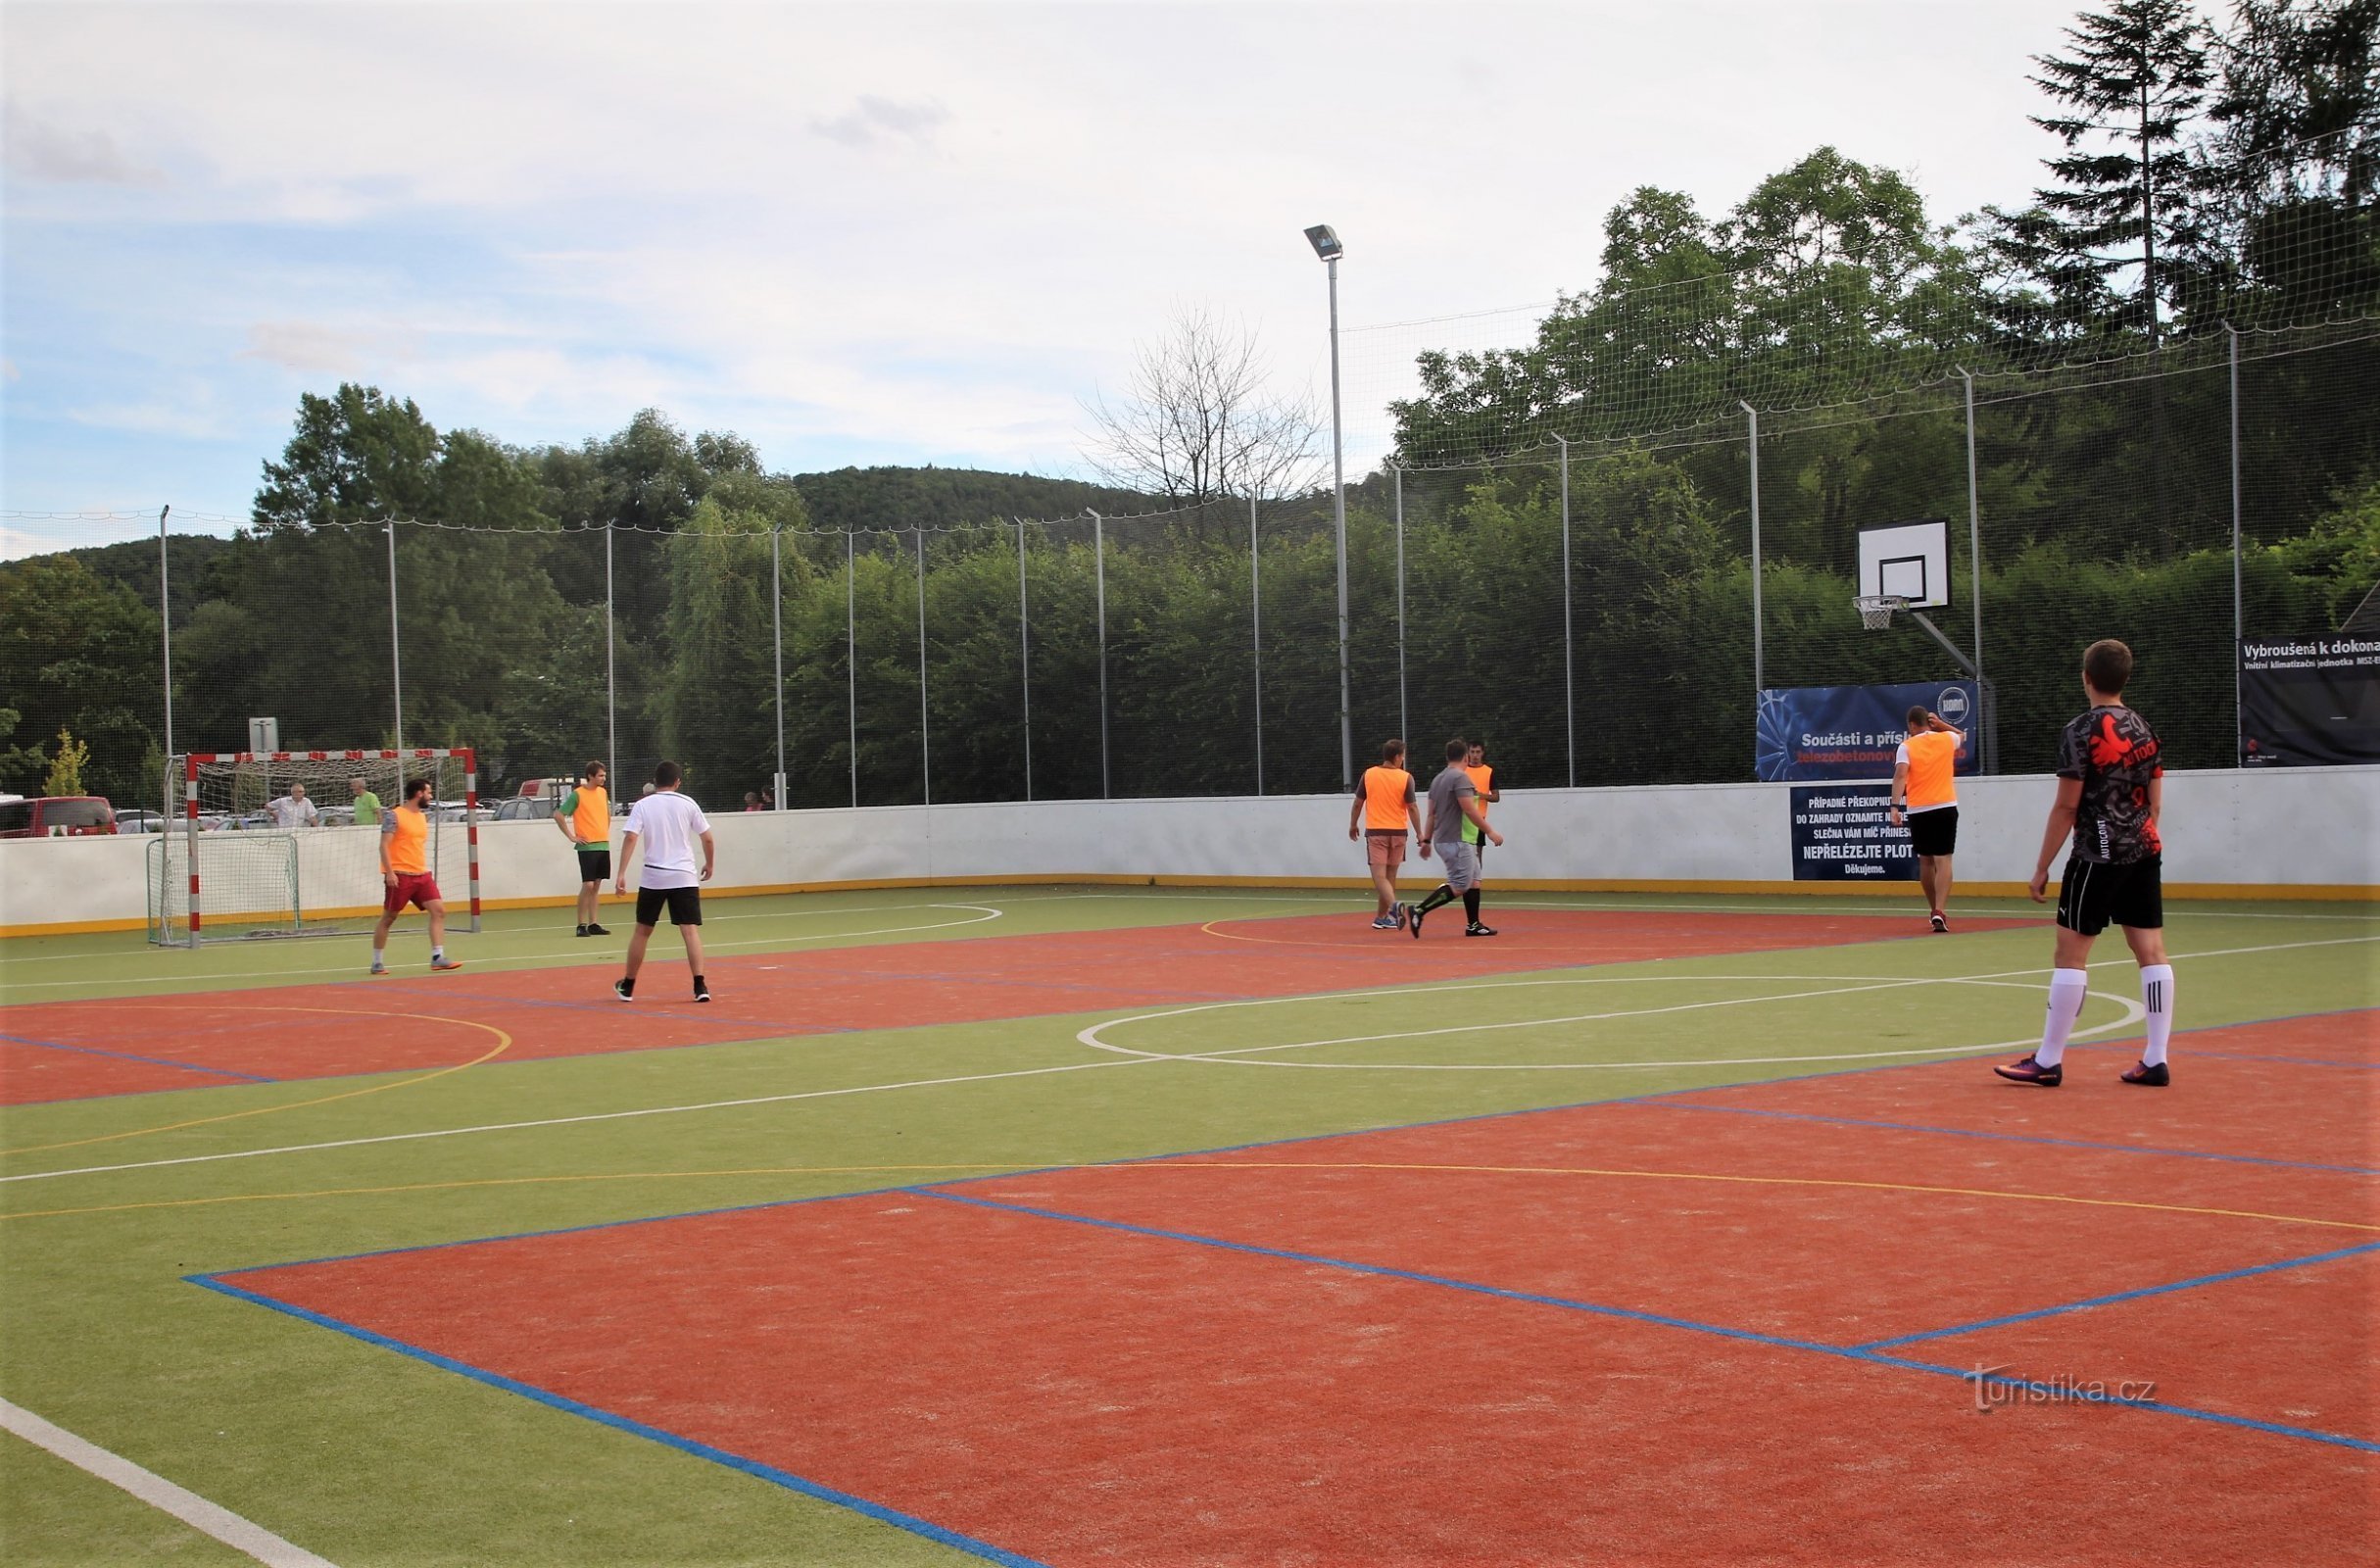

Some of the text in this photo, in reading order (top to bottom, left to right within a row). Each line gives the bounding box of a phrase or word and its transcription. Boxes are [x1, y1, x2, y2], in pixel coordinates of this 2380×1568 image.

[2244, 642, 2317, 661] Vybroušená
[2319, 641, 2329, 655] k
[2244, 661, 2268, 670] Vnitřní
[2270, 659, 2315, 669] klimatizační
[2316, 658, 2354, 669] jednotka
[1802, 731, 1861, 747] Součásti
[1865, 735, 1873, 745] a
[1809, 795, 1847, 808] PŘÍPADNÉ
[1796, 814, 1807, 824] DO
[1809, 812, 1844, 824] ZAHRADY
[1845, 811, 1883, 823] OZNAMTE
[1814, 827, 1843, 839] SLEČNA
[1844, 827, 1862, 839] VÁM
[1864, 826, 1878, 838] MÍČ
[2097, 819, 2111, 859] AUTOCONT
[1803, 843, 1914, 859] NEPŘELÉZEJTE PLOT
[1844, 863, 1885, 876] Děkujeme.
